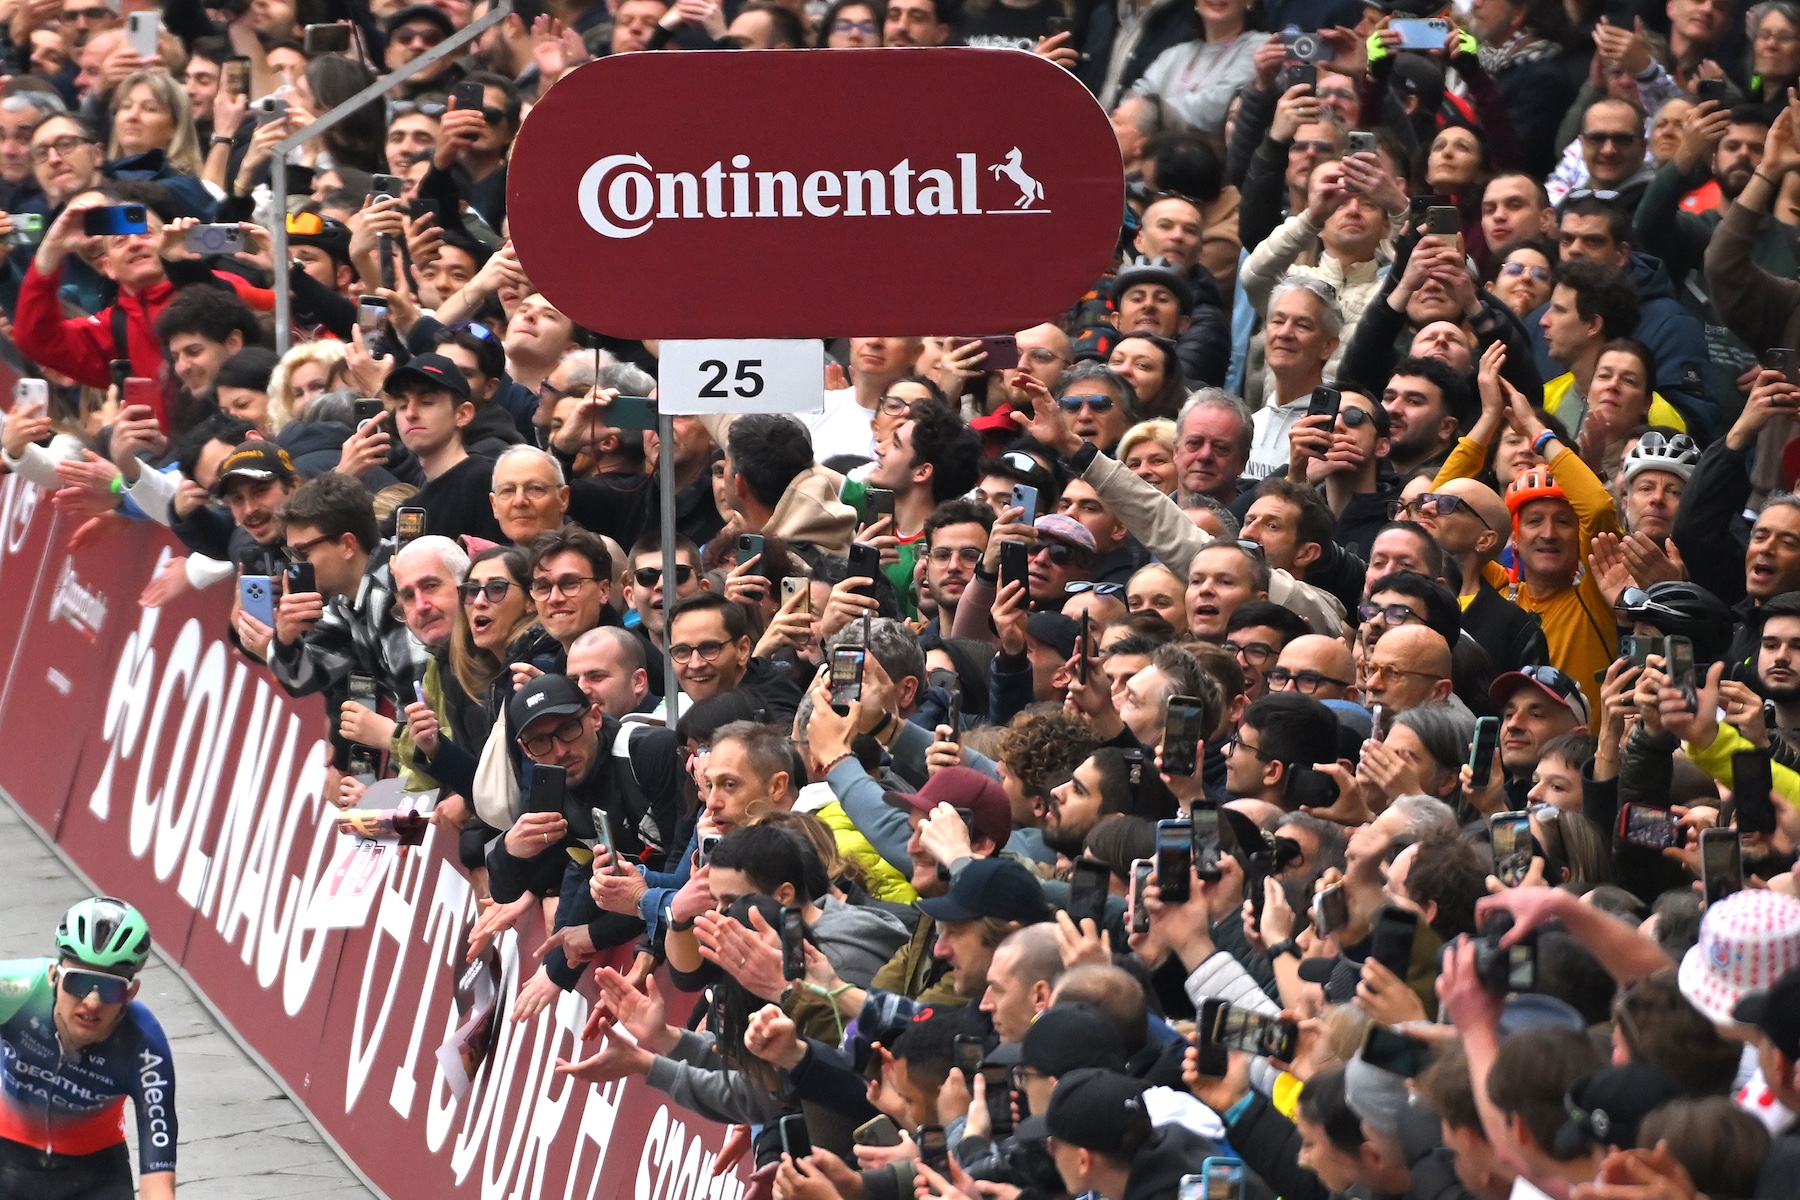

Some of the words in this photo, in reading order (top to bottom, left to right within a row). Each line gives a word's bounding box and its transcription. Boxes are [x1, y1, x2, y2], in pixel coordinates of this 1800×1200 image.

[577, 151, 983, 239] Continental
[697, 358, 766, 399] 25
[139, 1047, 169, 1148] Adecco
